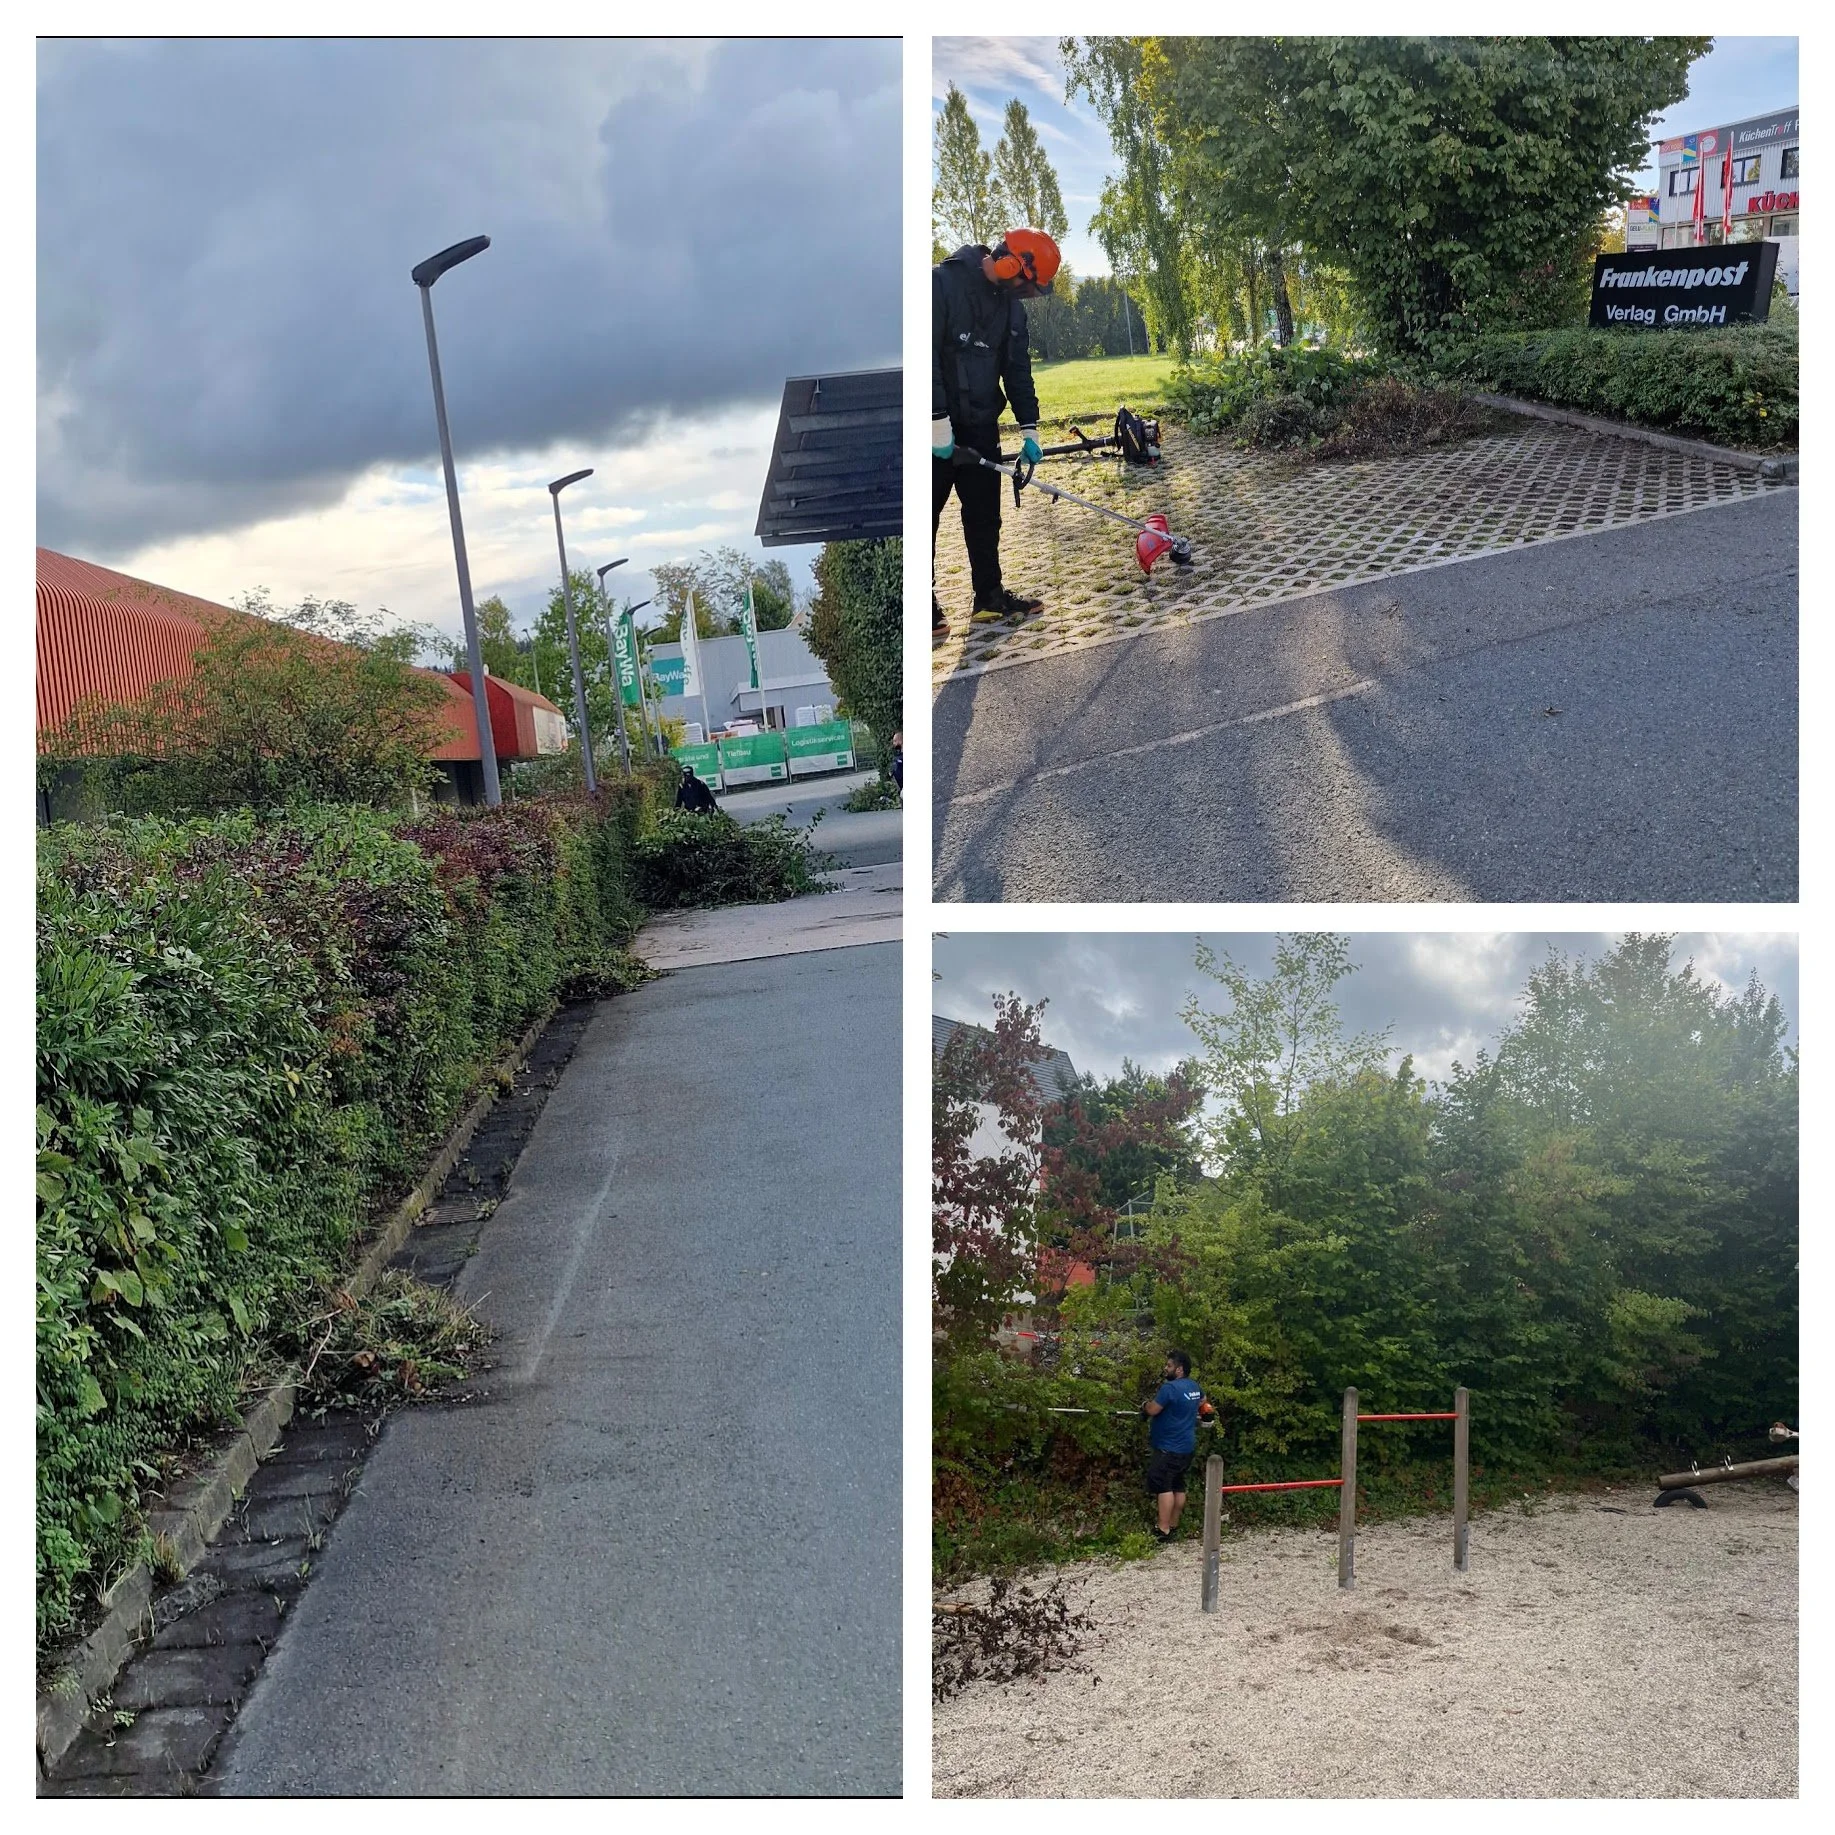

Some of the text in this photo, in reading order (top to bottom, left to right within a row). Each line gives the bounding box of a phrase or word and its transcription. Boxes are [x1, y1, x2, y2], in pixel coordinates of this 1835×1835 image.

[1599, 261, 1749, 290] Frankenpost
[1606, 304, 1727, 325] Verlag GmbH
[614, 623, 635, 687] BayWa
